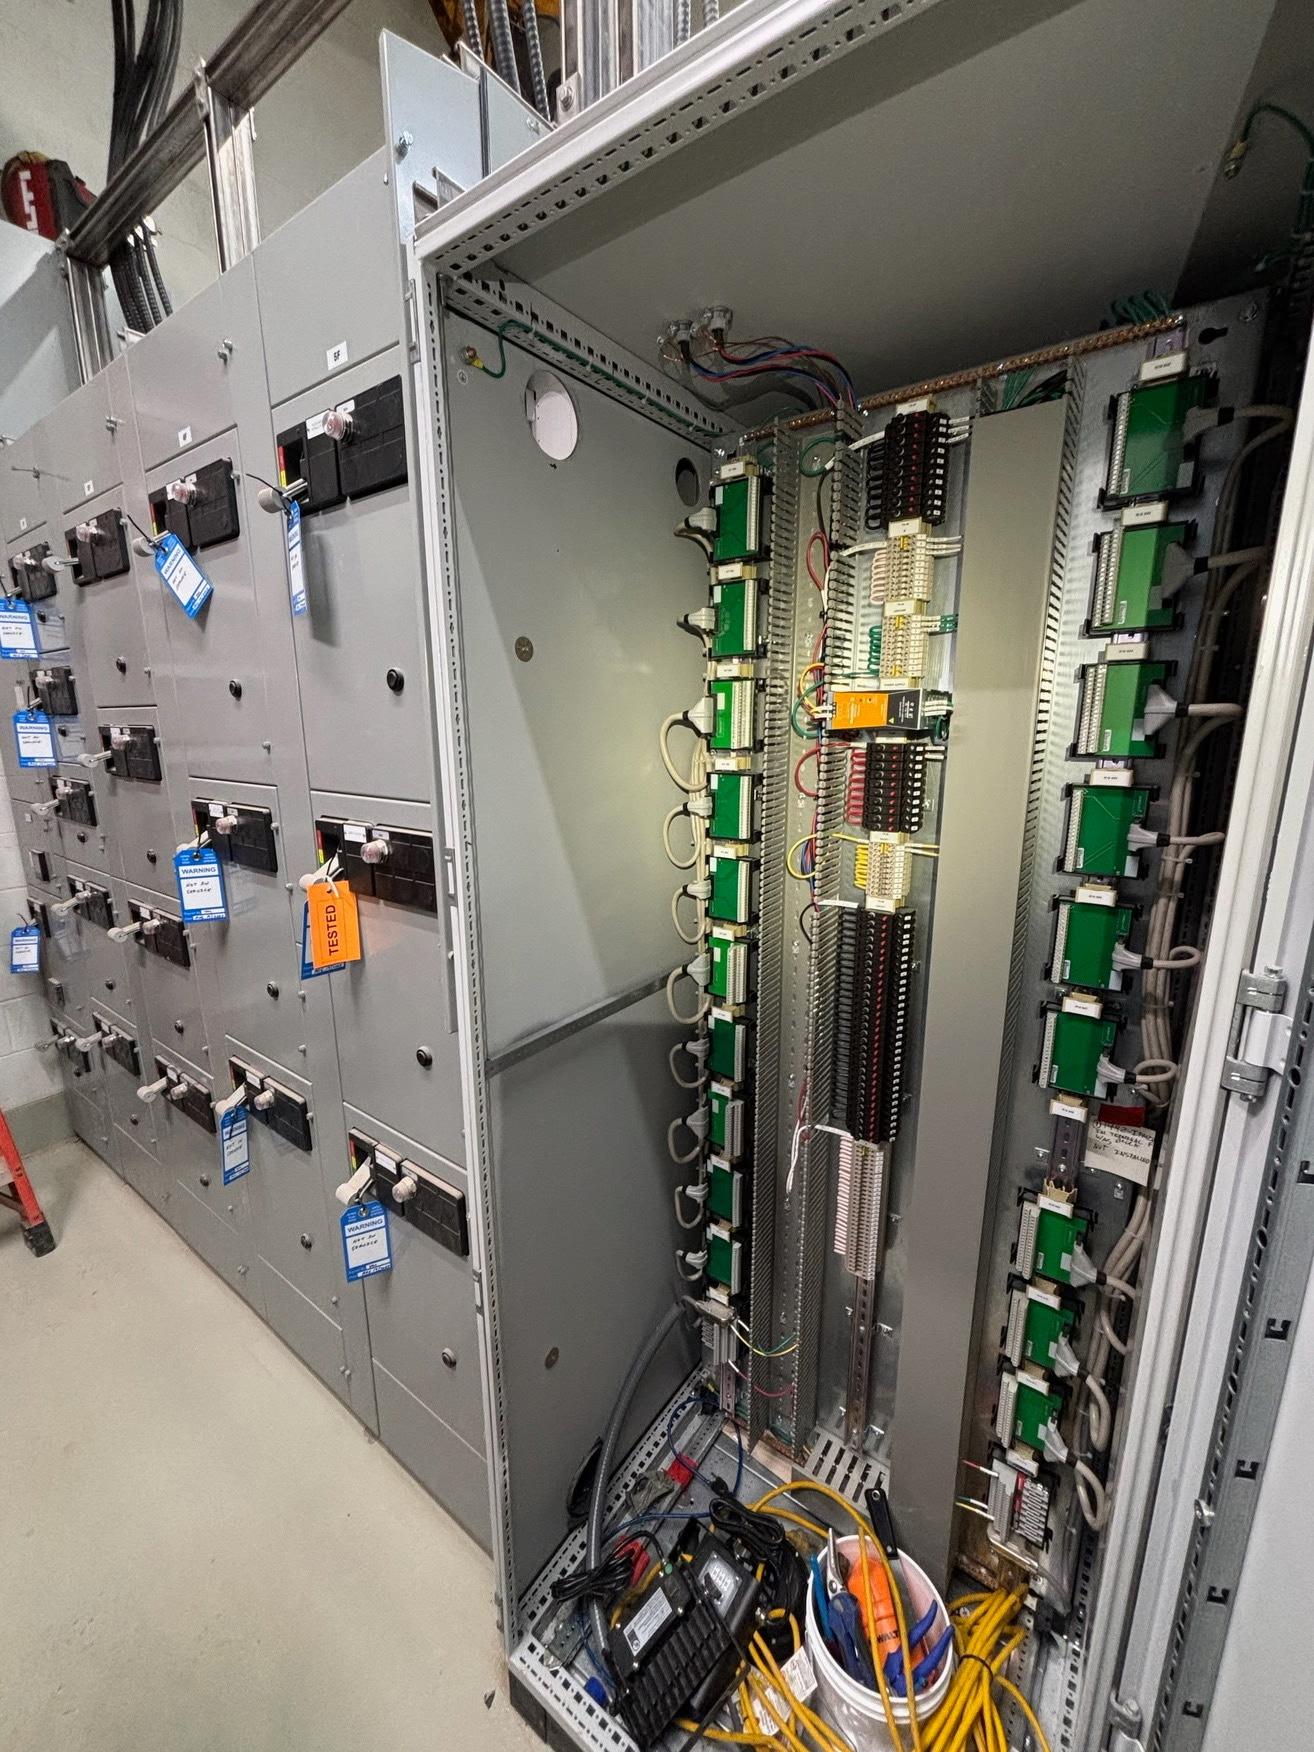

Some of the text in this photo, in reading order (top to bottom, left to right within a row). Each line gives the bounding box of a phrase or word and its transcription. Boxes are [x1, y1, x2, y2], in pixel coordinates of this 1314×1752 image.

[182, 866, 216, 875] WARNING
[325, 904, 339, 956] TESTED
[347, 1218, 383, 1233] WARNING
